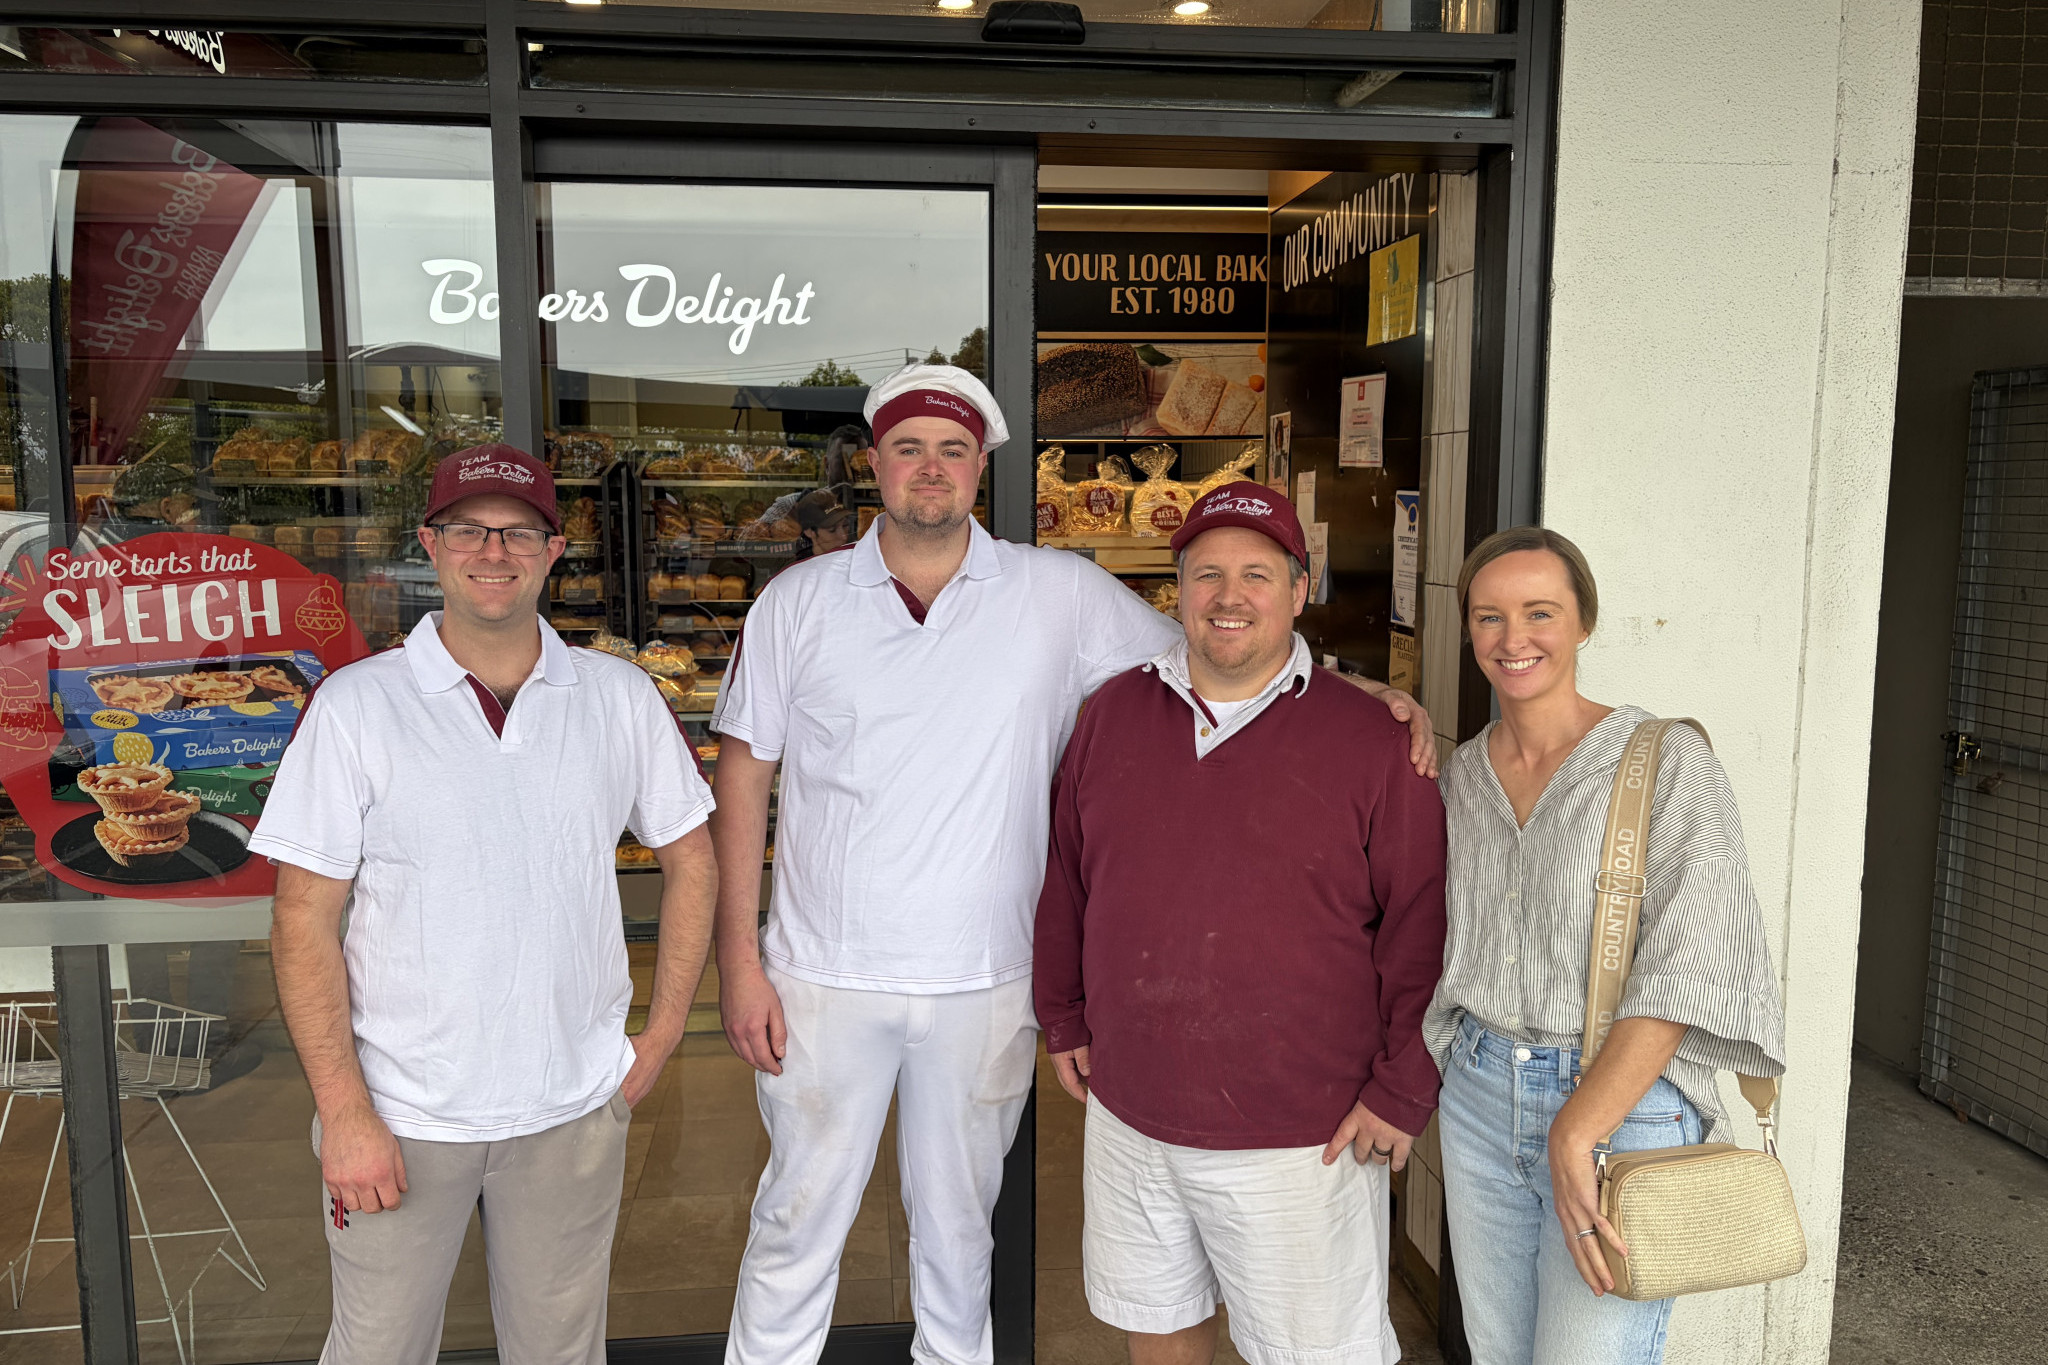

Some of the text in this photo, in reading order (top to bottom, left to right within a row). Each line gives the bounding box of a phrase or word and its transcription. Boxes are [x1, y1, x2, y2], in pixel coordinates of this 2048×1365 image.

[1284, 173, 1415, 293] OUR COMMUNITY
[1045, 252, 1268, 282] YOUR LOCAL BAK
[421, 258, 816, 355] Baers Delight
[1110, 286, 1235, 315] EST. 1980
[924, 395, 950, 408] Bakers
[459, 454, 490, 467] TEAM
[458, 464, 535, 484] Bakers Delight
[1202, 501, 1233, 516] Bakers
[1236, 499, 1273, 516] Delight
[1206, 491, 1231, 505] TEAM
[1036, 504, 1053, 516] AKE
[1156, 510, 1175, 519] BEST
[46, 545, 257, 581] Serve tarts that
[43, 578, 282, 650] SLEIGH
[183, 737, 283, 758] Bakers Delight
[1603, 880, 1631, 971] COUNTRY
